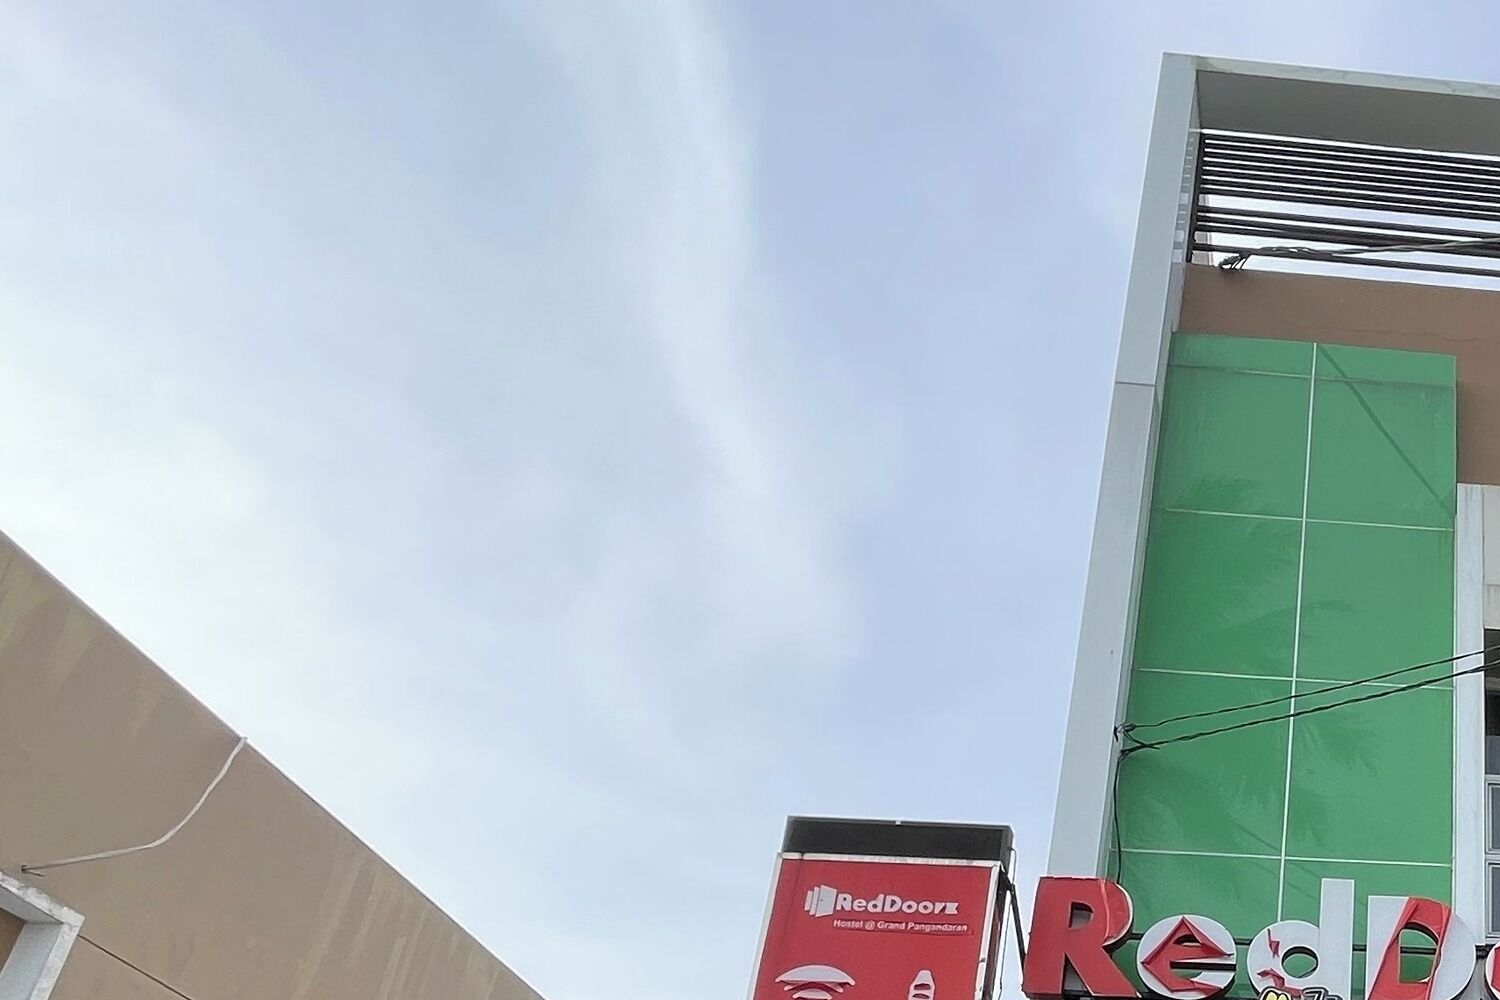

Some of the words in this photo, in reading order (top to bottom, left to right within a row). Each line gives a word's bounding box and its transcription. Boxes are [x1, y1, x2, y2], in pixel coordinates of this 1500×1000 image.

[833, 918, 864, 929] Hostel
[865, 920, 876, 931] @
[877, 920, 906, 930] Grand
[907, 922, 968, 932] Pangandaran
